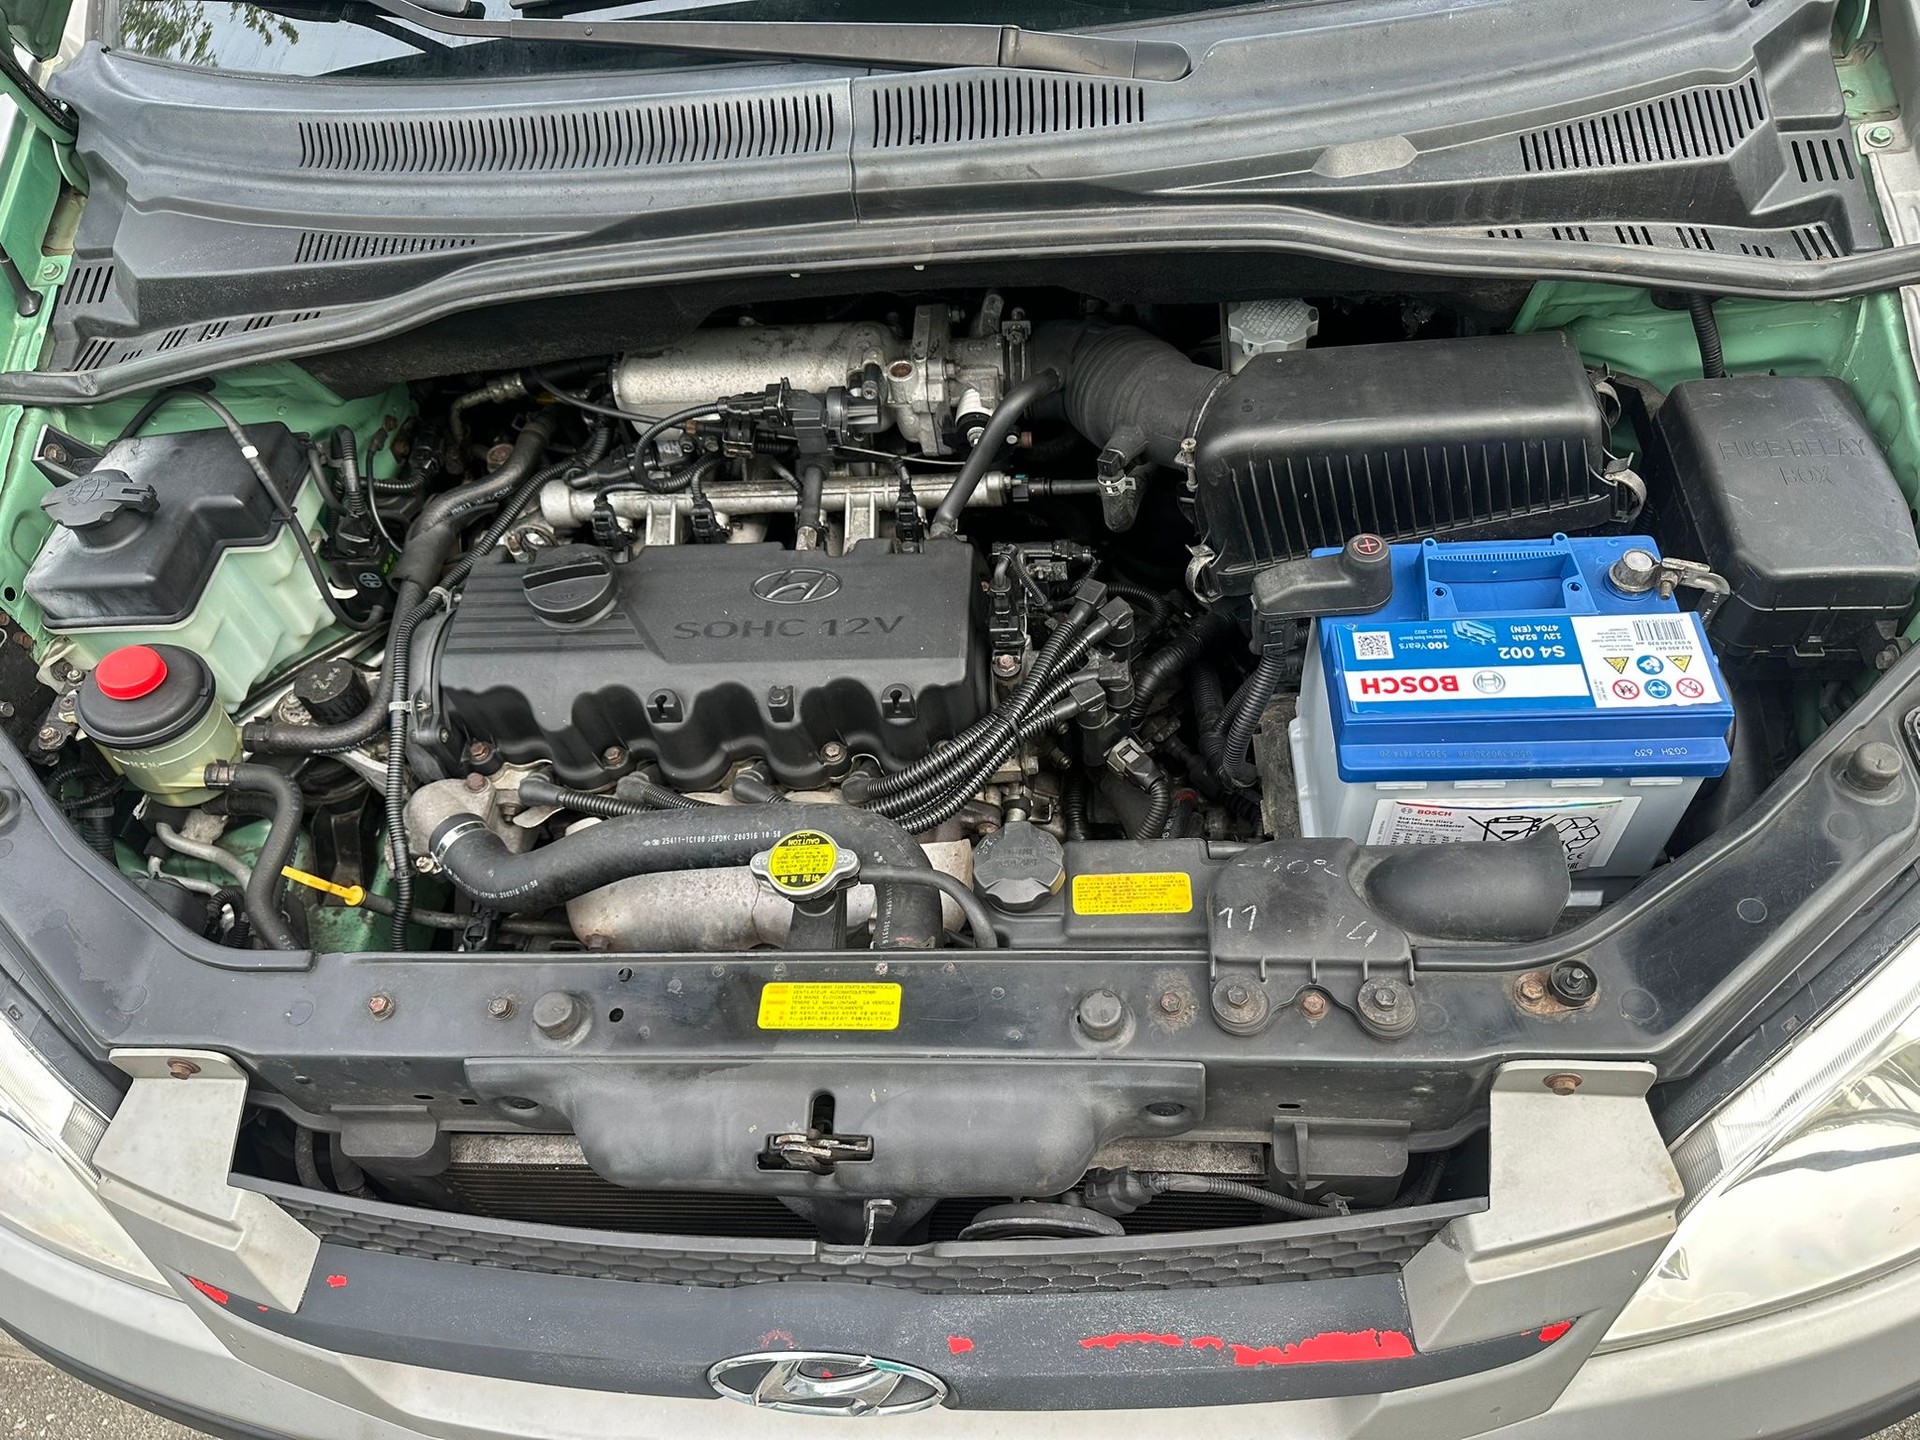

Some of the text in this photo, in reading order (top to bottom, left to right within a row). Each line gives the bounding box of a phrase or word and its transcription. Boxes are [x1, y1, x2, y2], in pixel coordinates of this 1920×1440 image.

[1718, 437, 1866, 461] FUSE-RELAY
[1779, 465, 1836, 486] BOX
[673, 615, 904, 640] SOHC 12V
[1510, 624, 1559, 633] 470A (EN)
[1512, 632, 1562, 642] 12V 52Ah
[1398, 641, 1450, 651] 100 Years
[1498, 645, 1566, 660] S4 002
[1360, 675, 1460, 694] BOSCH
[1634, 747, 1688, 757] CG3H 639
[1417, 809, 1453, 817] BOSCH
[661, 835, 706, 846] 25411-1C100
[734, 832, 758, 841] 200316
[788, 838, 820, 846] CAUTION
[755, 857, 768, 866] 0.9
[838, 854, 855, 864] HCC
[1143, 874, 1176, 882] CAUTION
